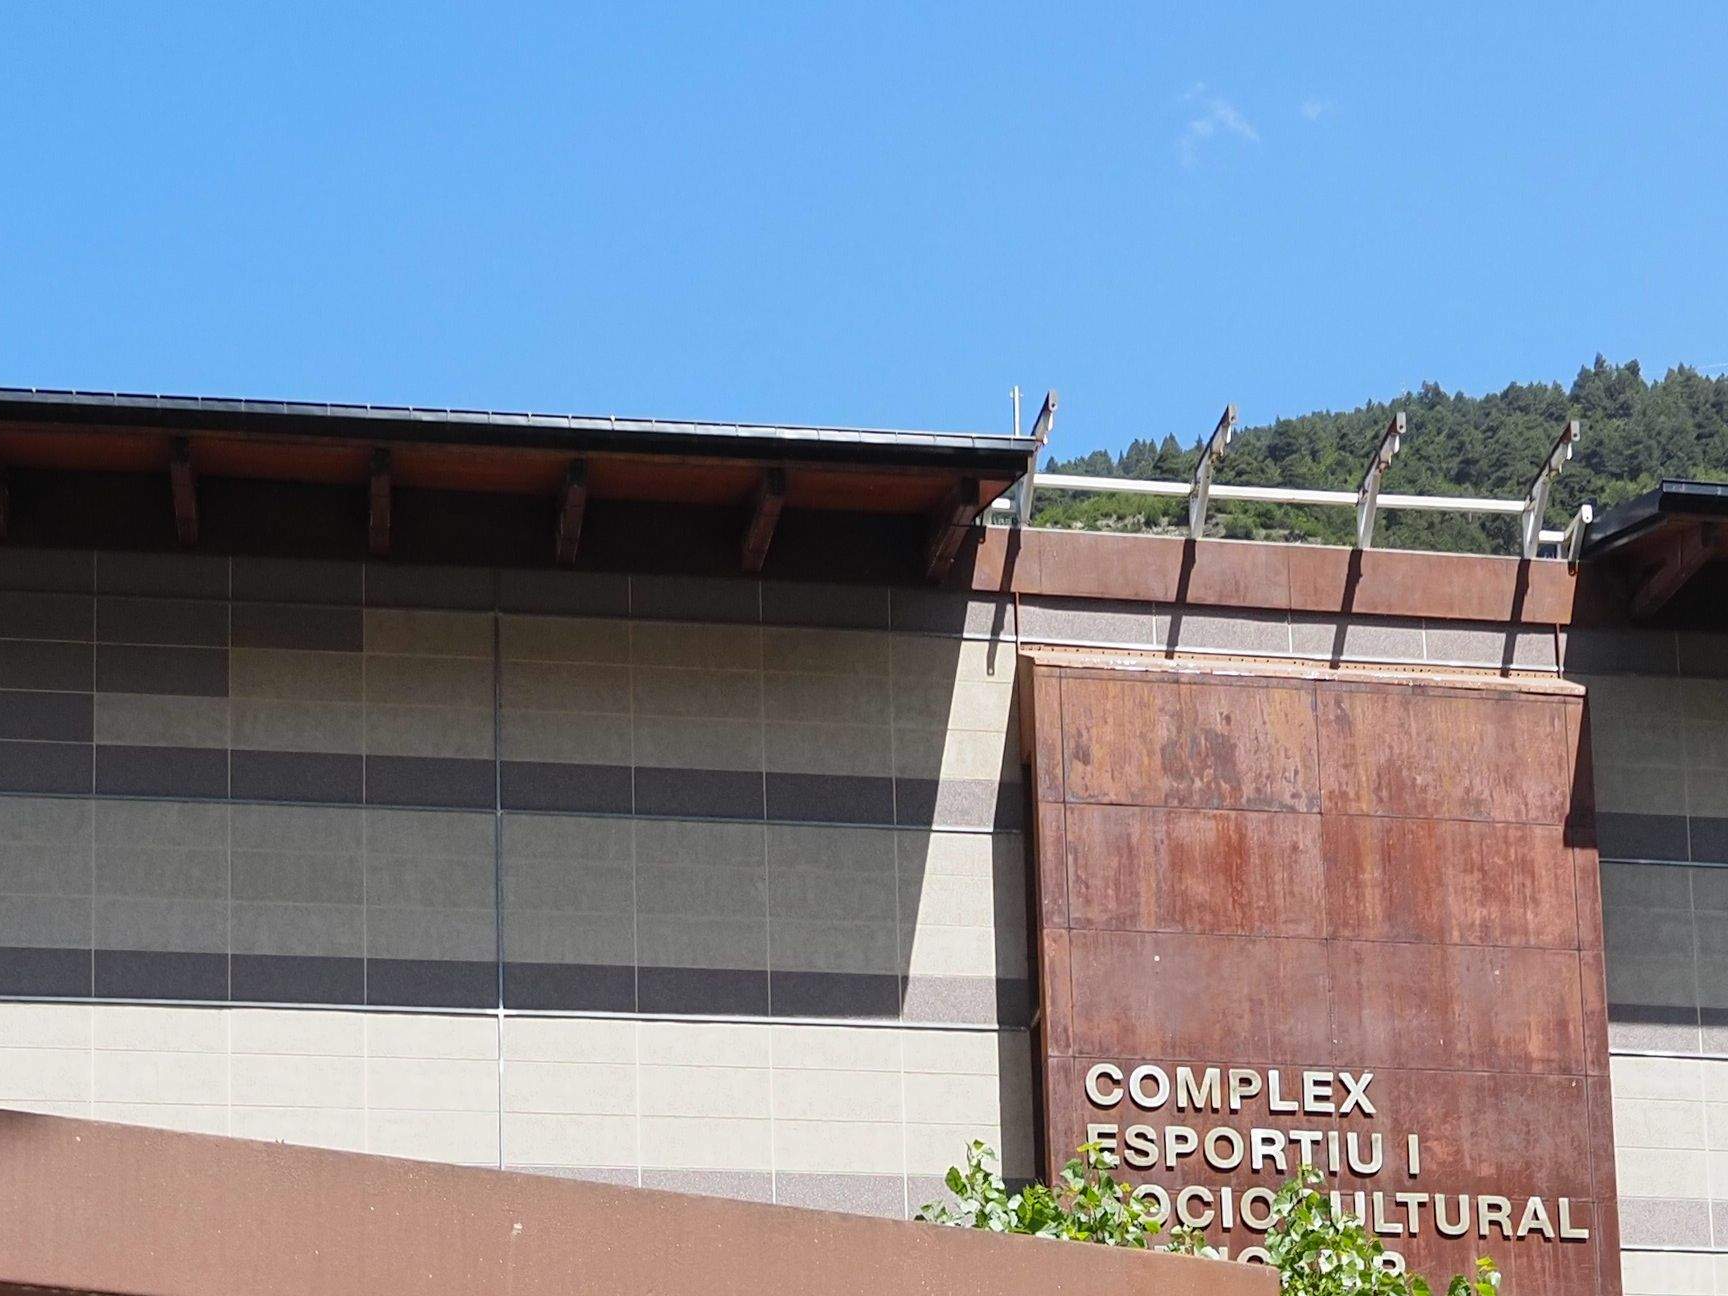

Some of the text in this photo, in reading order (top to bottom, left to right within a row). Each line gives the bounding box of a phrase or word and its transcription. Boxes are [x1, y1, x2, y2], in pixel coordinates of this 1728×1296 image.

[1084, 1062, 1377, 1115] COMPLEX
[1086, 1123, 1421, 1175] ESPORTIU I
[1090, 1183, 1590, 1240] OCIOULTURAL
